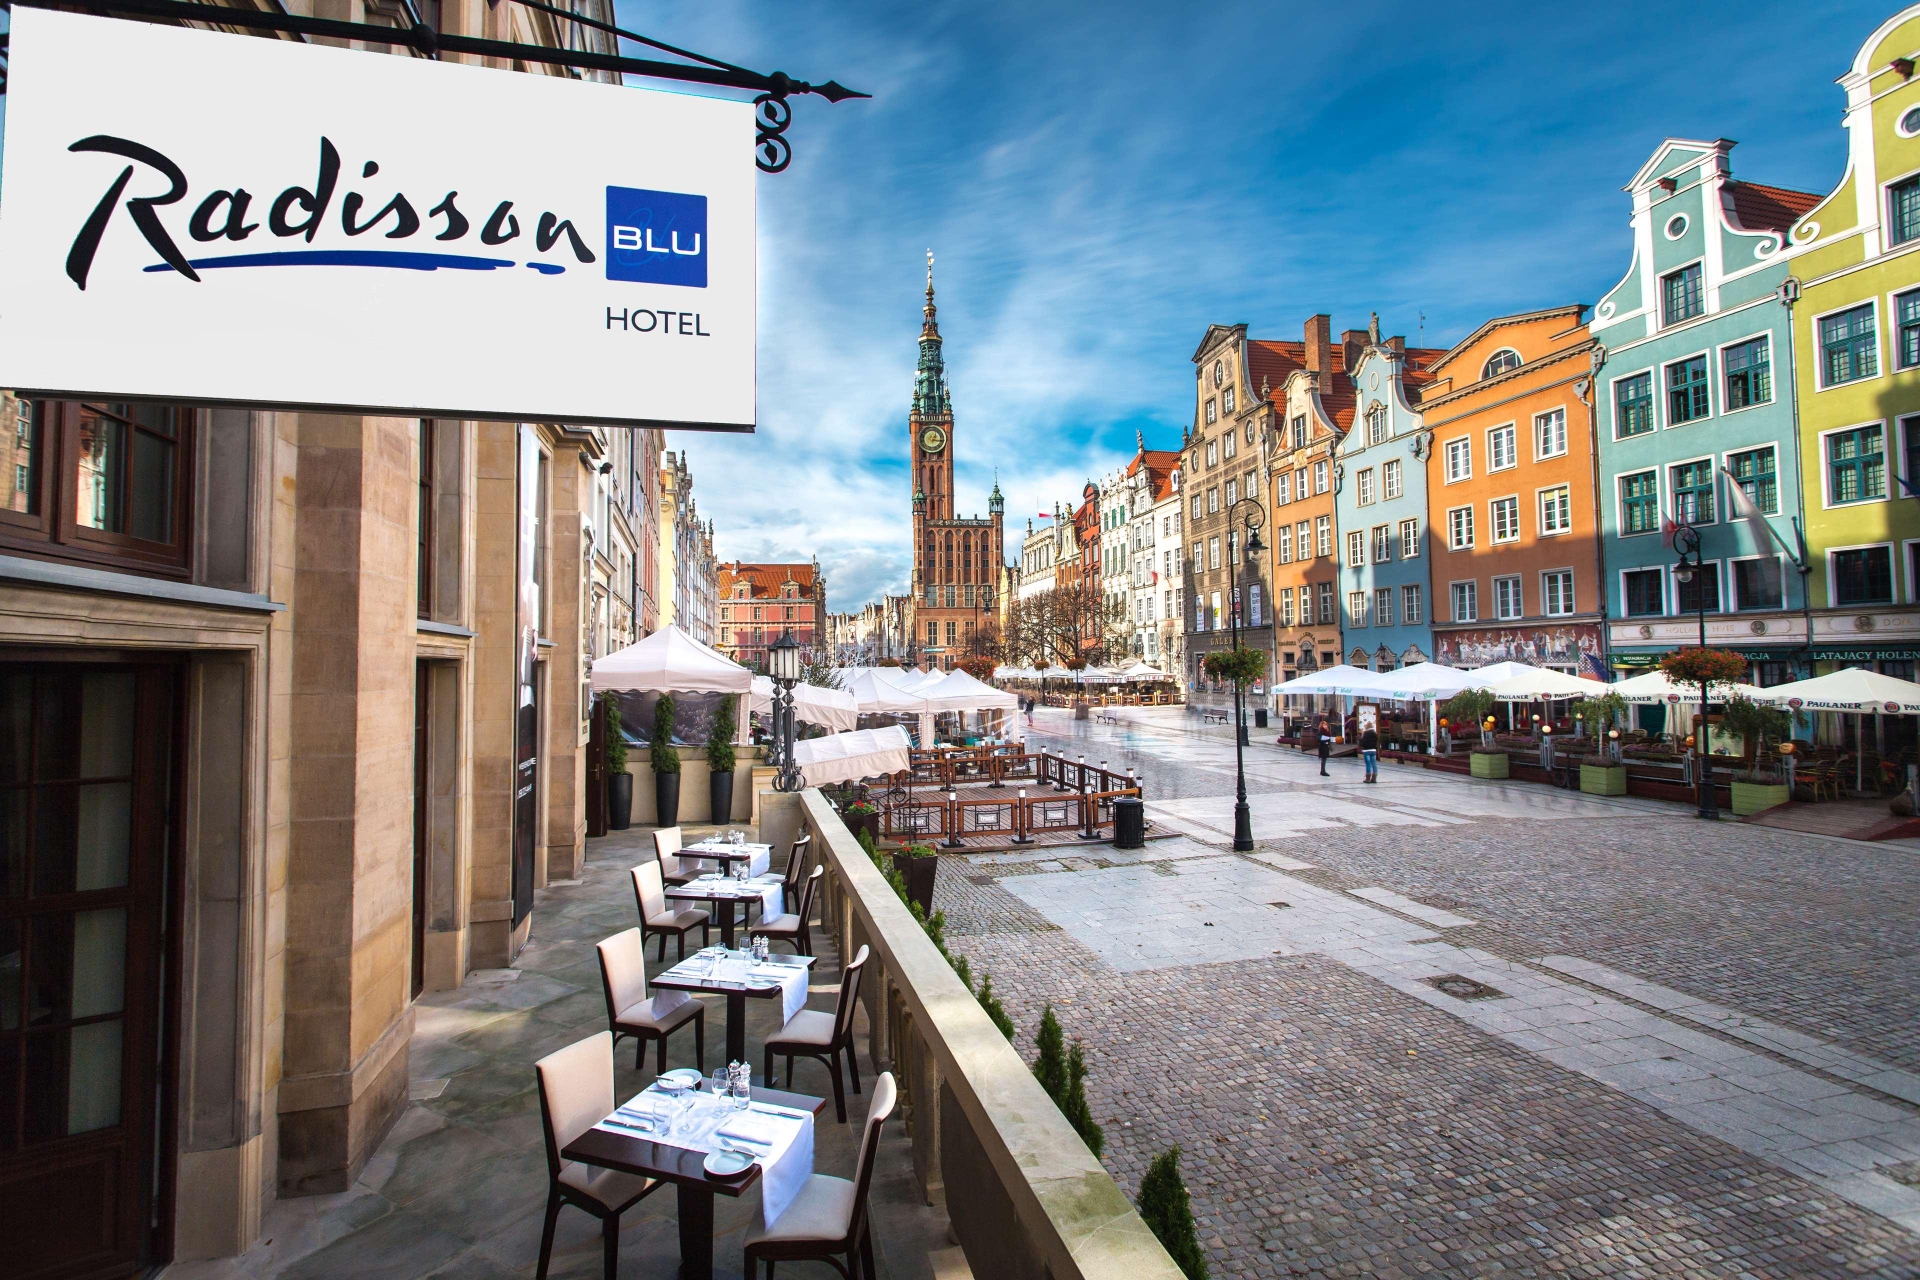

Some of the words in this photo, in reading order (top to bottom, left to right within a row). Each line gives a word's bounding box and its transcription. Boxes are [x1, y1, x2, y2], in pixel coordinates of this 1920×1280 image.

[65, 134, 596, 291] Radisson
[613, 225, 701, 256] BLU
[606, 306, 711, 337] HOTEL
[1210, 636, 1242, 646] GALERA
[1806, 700, 1862, 710] PAULANER
